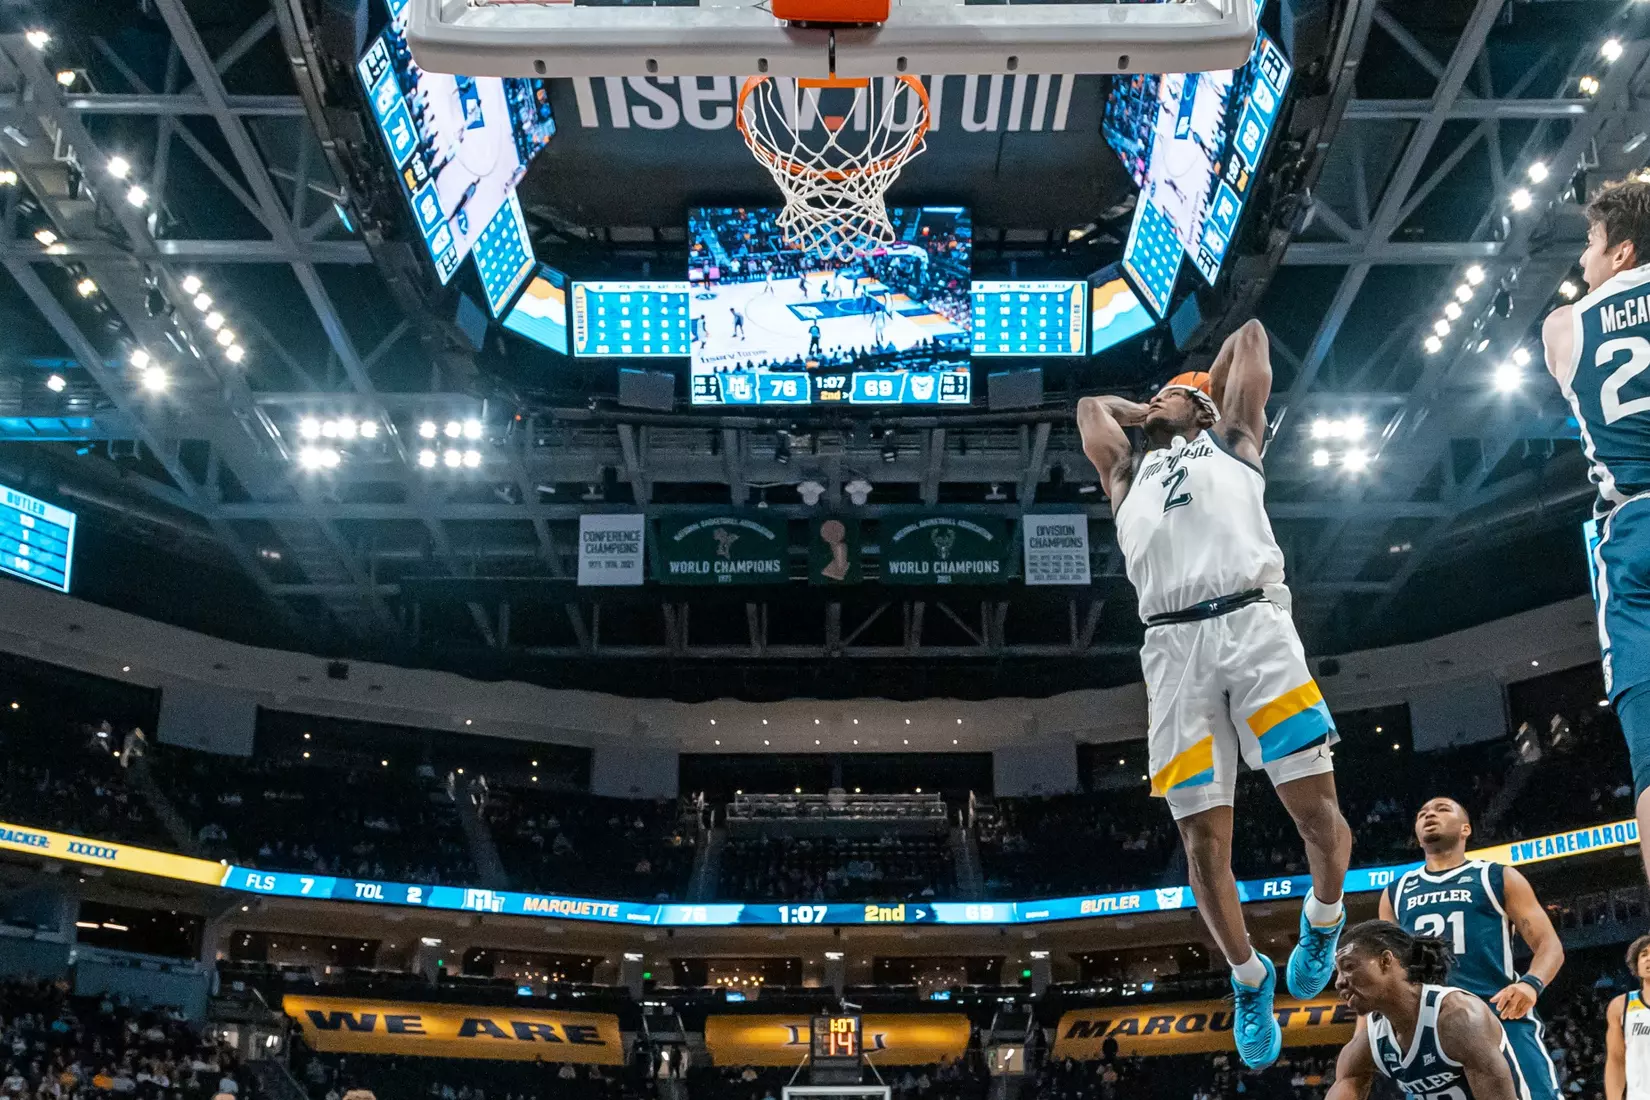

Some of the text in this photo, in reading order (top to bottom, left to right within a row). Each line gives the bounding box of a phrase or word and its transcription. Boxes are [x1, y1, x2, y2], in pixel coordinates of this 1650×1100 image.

[770, 380, 797, 397] 76
[815, 376, 846, 389] 1:07
[864, 380, 893, 397] 69
[1161, 465, 1194, 514] 2
[7, 491, 46, 516] BUTLER
[583, 530, 641, 542] CONFERENCE
[1036, 524, 1076, 537] DIVISION
[585, 542, 639, 554] CHAMPIONS
[1029, 536, 1084, 549] CHAMPIONS
[669, 559, 781, 574] WORLD CHAMPIONS
[889, 559, 1000, 574] WORLD CHAMPIONS
[245, 873, 315, 895] FLS 7
[354, 882, 423, 904] TOL 2
[1263, 879, 1292, 897] FLS
[523, 896, 620, 918] MARQUETTE
[1080, 894, 1140, 914] BUTLER
[1406, 889, 1473, 911] BUTLER
[680, 906, 708, 922] 76
[778, 904, 828, 923] 1:07
[864, 903, 906, 922] 2nd
[965, 904, 995, 921] 69
[304, 1009, 607, 1047] WE ARE
[830, 1018, 856, 1033] 1:07
[1063, 1004, 1358, 1040] MARQUTTE
[829, 1032, 853, 1056] 14
